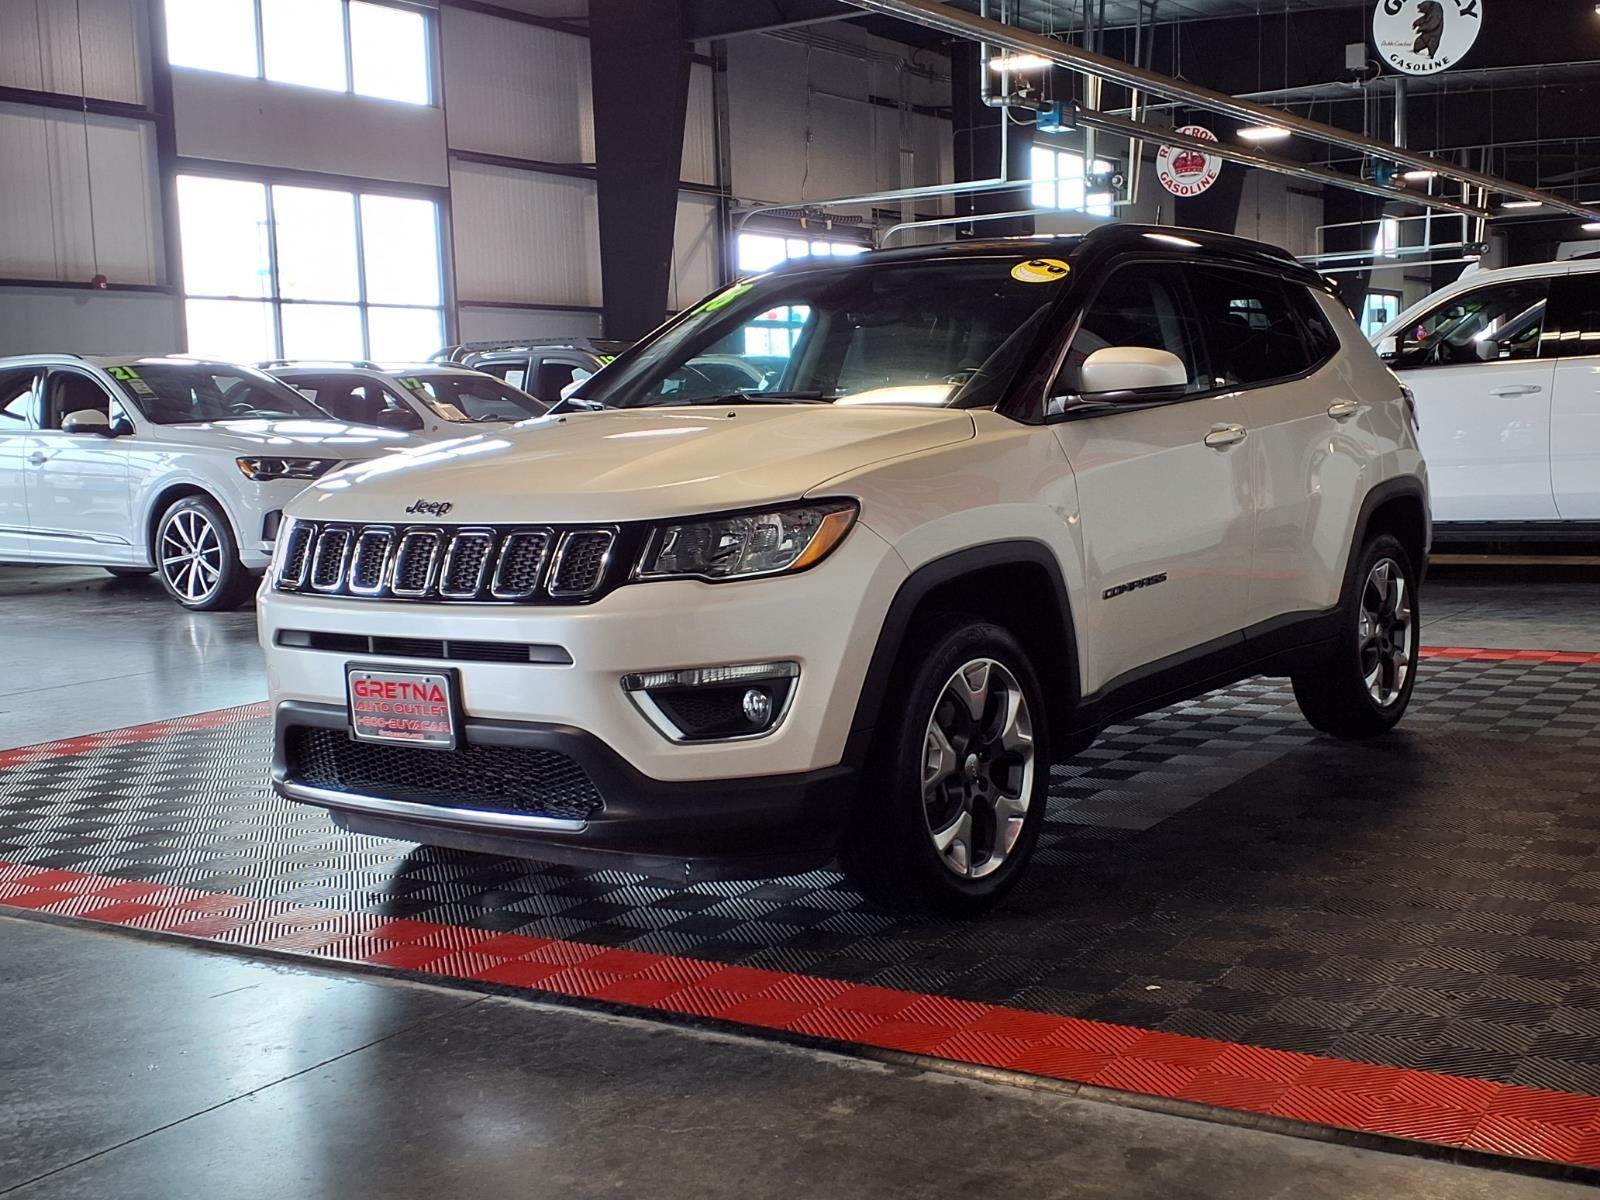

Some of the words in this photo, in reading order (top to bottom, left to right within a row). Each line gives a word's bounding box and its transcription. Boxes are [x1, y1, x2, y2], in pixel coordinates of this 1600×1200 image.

[1390, 54, 1450, 71] GASOLINE
[1160, 169, 1217, 195] GASOLINE
[108, 366, 140, 380] 21
[398, 377, 423, 390] 17
[405, 499, 453, 517] Jeep
[1102, 572, 1167, 600] COMPASS
[354, 680, 445, 702] GRETNA
[356, 702, 390, 713] AUTO
[394, 703, 448, 718] OUTLET
